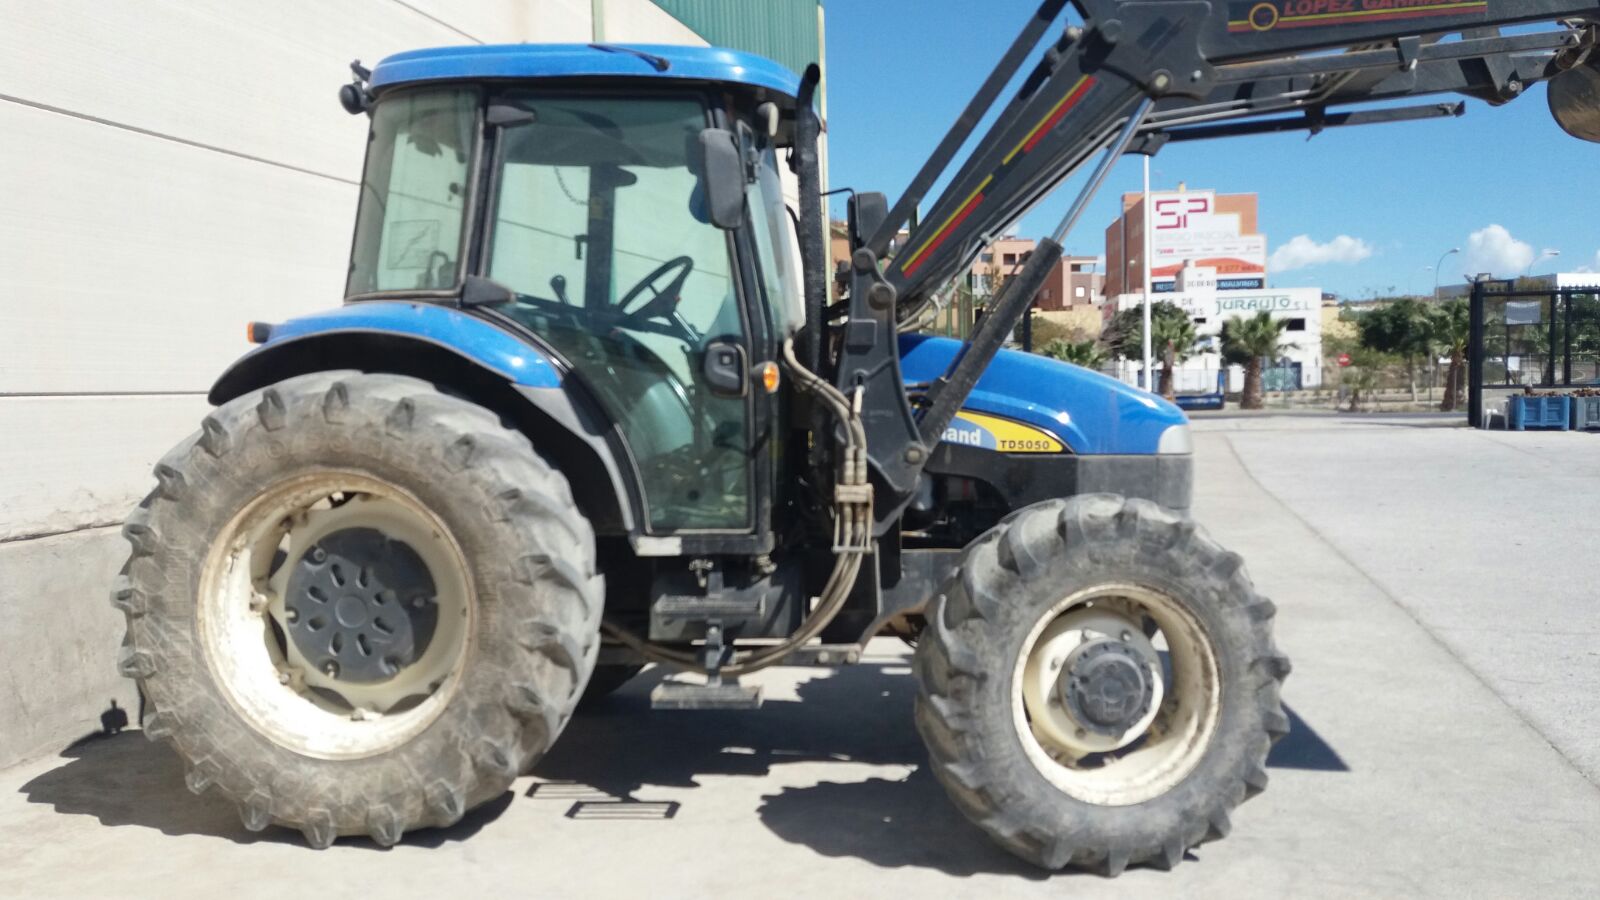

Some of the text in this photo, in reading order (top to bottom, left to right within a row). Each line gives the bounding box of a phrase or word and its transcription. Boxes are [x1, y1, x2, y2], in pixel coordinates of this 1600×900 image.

[1283, 0, 1354, 16] LOPEZ
[1155, 198, 1208, 229] SP
[1215, 296, 1290, 315] JURAUTO
[1000, 440, 1050, 449] TD5050
